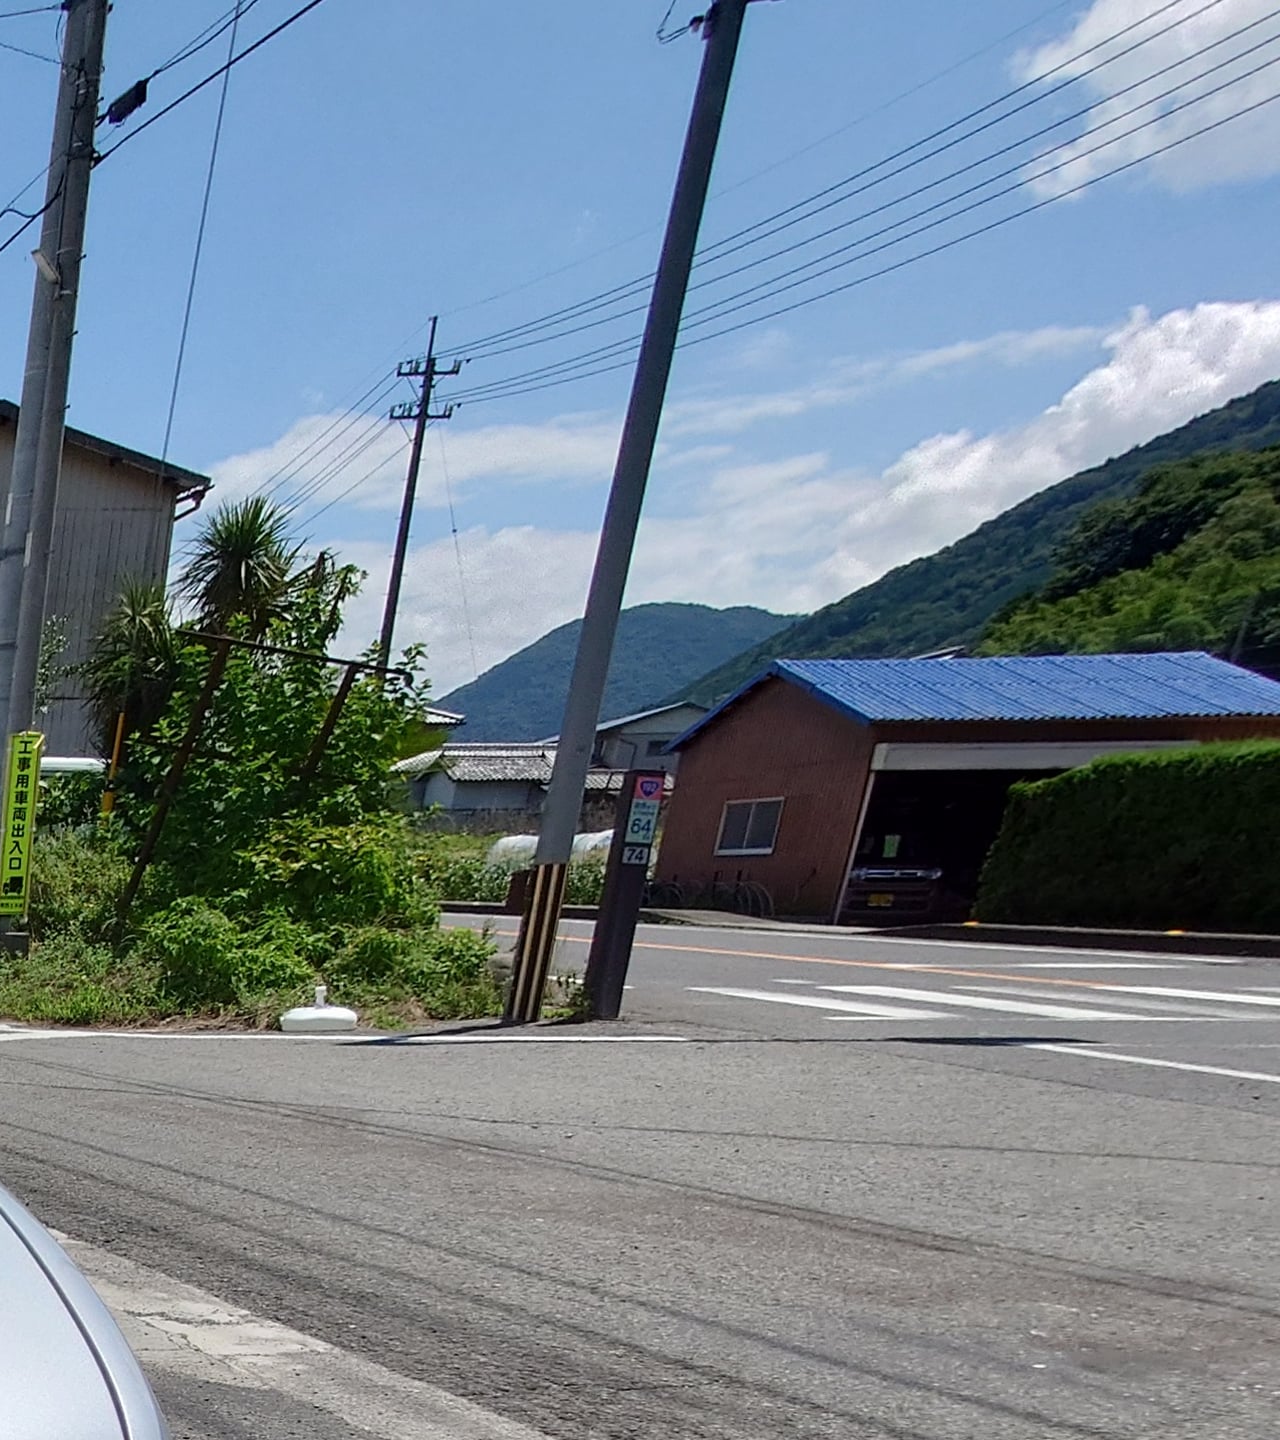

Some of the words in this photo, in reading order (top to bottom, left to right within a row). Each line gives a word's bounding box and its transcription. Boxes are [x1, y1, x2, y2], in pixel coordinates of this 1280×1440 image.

[8, 740, 33, 871] 工事用車両出入口
[631, 818, 652, 834] 64
[626, 847, 645, 862] 74
